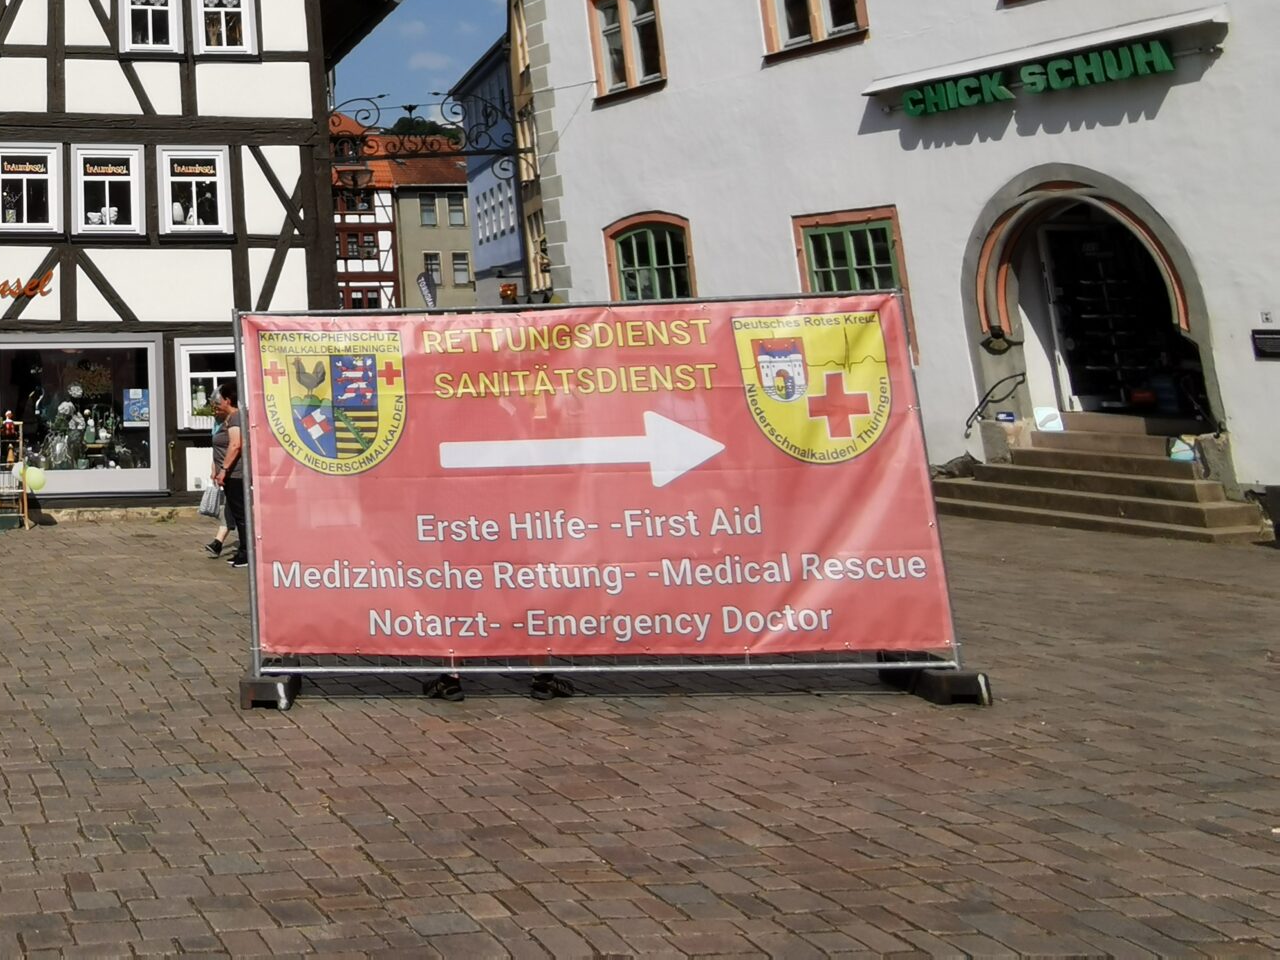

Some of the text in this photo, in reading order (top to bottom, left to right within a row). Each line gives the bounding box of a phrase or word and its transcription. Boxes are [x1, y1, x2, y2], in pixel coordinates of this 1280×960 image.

[903, 40, 1174, 117] CHICK SCHUH
[260, 332, 399, 342] KATASTROPHENSCHUTZ
[422, 319, 711, 354] RETTUNGSDIENST
[733, 314, 877, 330] Deutsches Rotes Kreuz
[261, 344, 400, 354] SCHMALKALDEN-MEININGEN
[434, 363, 717, 399] SANITÄTSDIENST
[857, 376, 890, 444] Thüringen
[266, 394, 404, 472] STANDORT NIEDERSCHMALKALDEN
[416, 505, 762, 541] Erste Hilfe- -First Aid
[271, 552, 927, 595] Medizinische Rettung- -Medical Rescue
[369, 604, 832, 642] Notarzt- -Emergency Doctor
